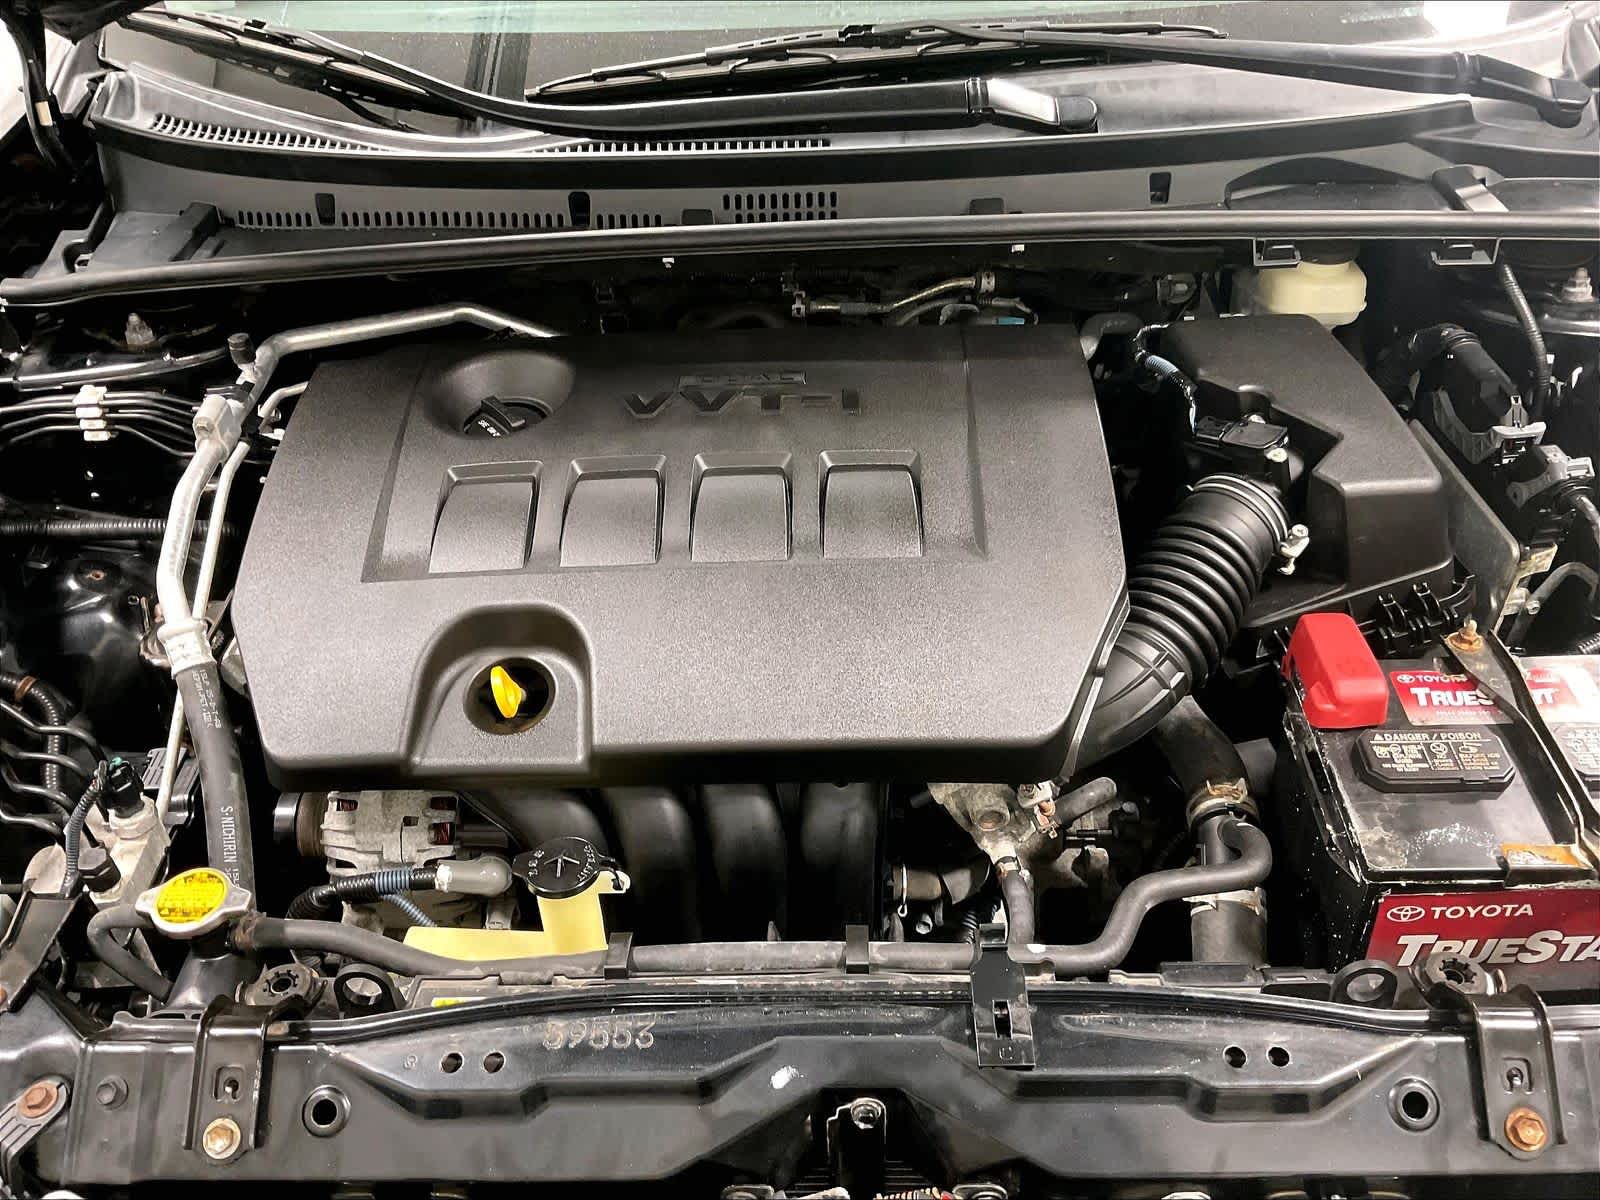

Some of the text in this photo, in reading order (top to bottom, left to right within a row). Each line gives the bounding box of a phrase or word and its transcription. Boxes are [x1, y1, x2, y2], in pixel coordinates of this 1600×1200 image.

[1384, 732, 1429, 741] DANGER
[1440, 731, 1481, 740] POISON
[1431, 904, 1533, 919] TOYOTA
